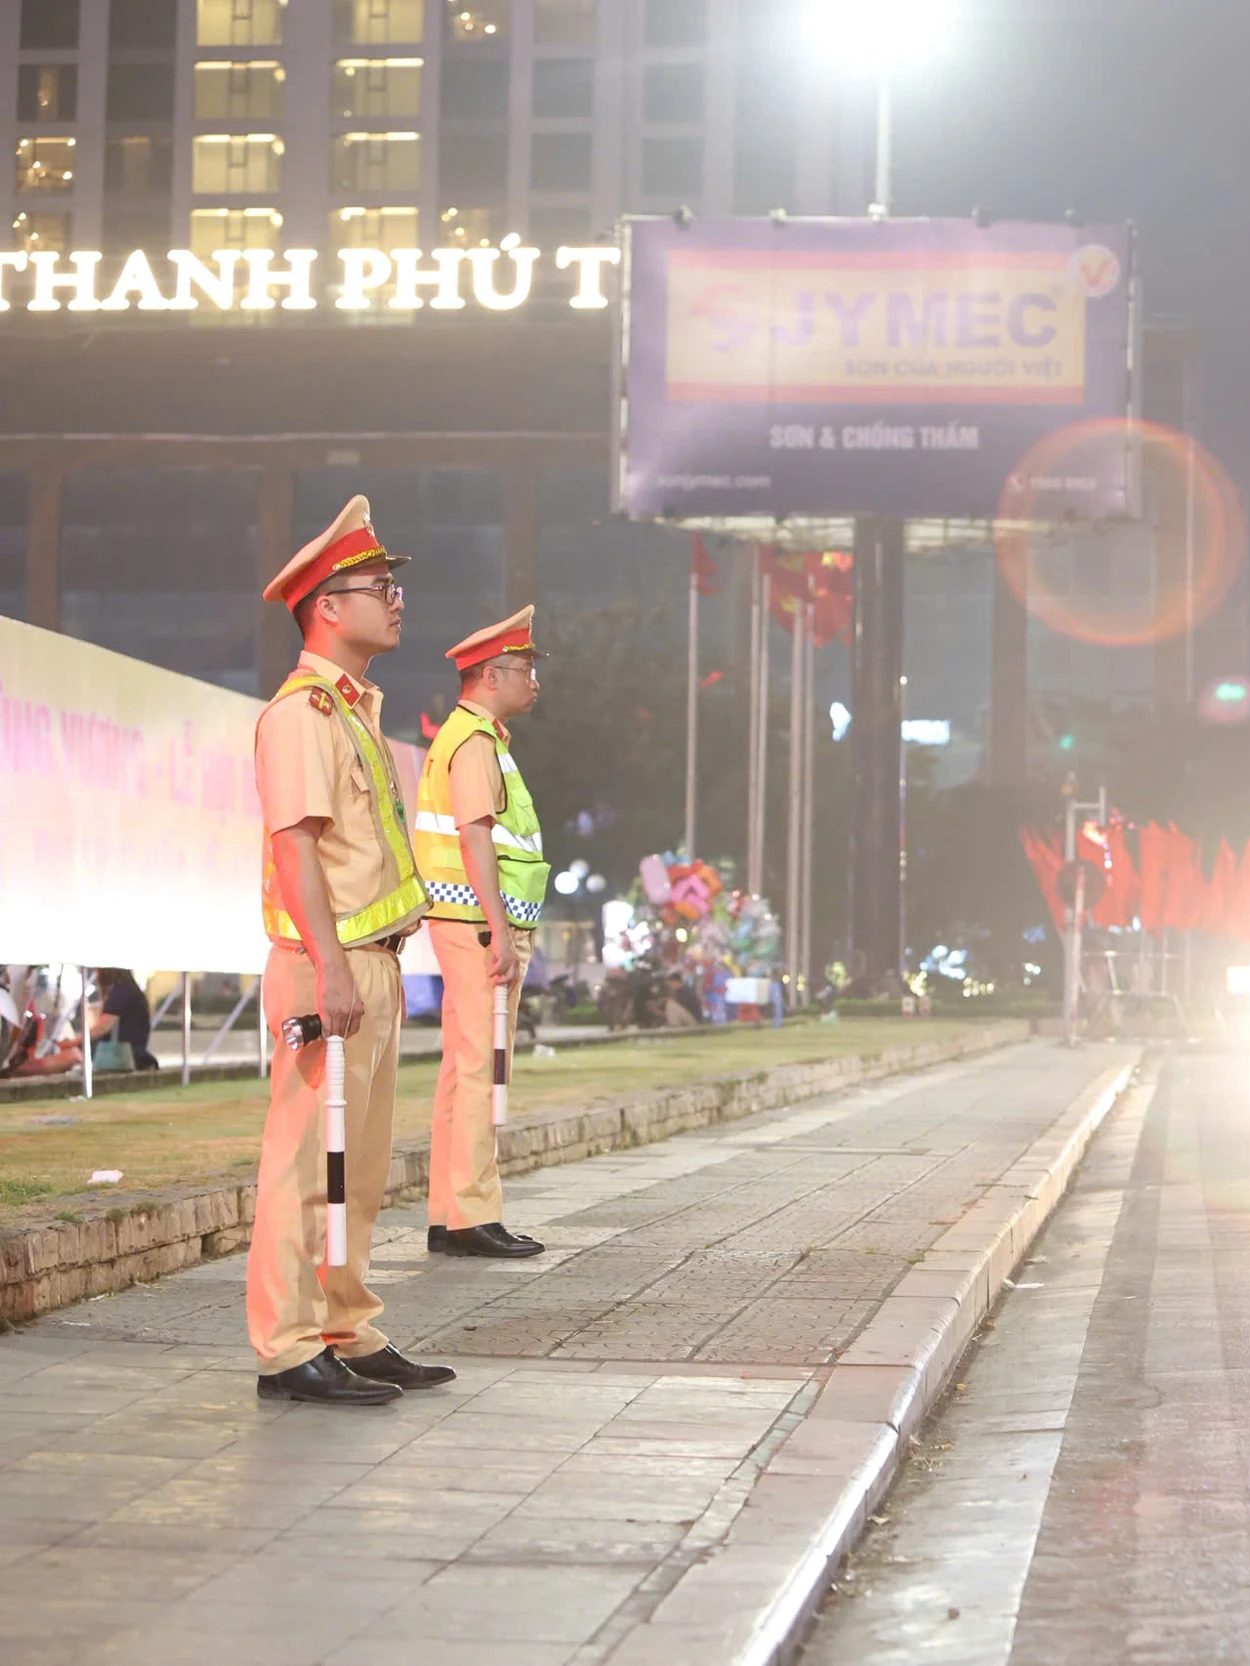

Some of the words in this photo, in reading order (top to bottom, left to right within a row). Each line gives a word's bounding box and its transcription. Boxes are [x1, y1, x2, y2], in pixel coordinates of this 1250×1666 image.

[335, 232, 540, 311] PHÚ
[770, 290, 1058, 349] JYMEC
[769, 423, 815, 448] SƠN
[819, 425, 835, 448] &
[841, 419, 915, 448] CHỐNG
[919, 418, 979, 448] THẤM
